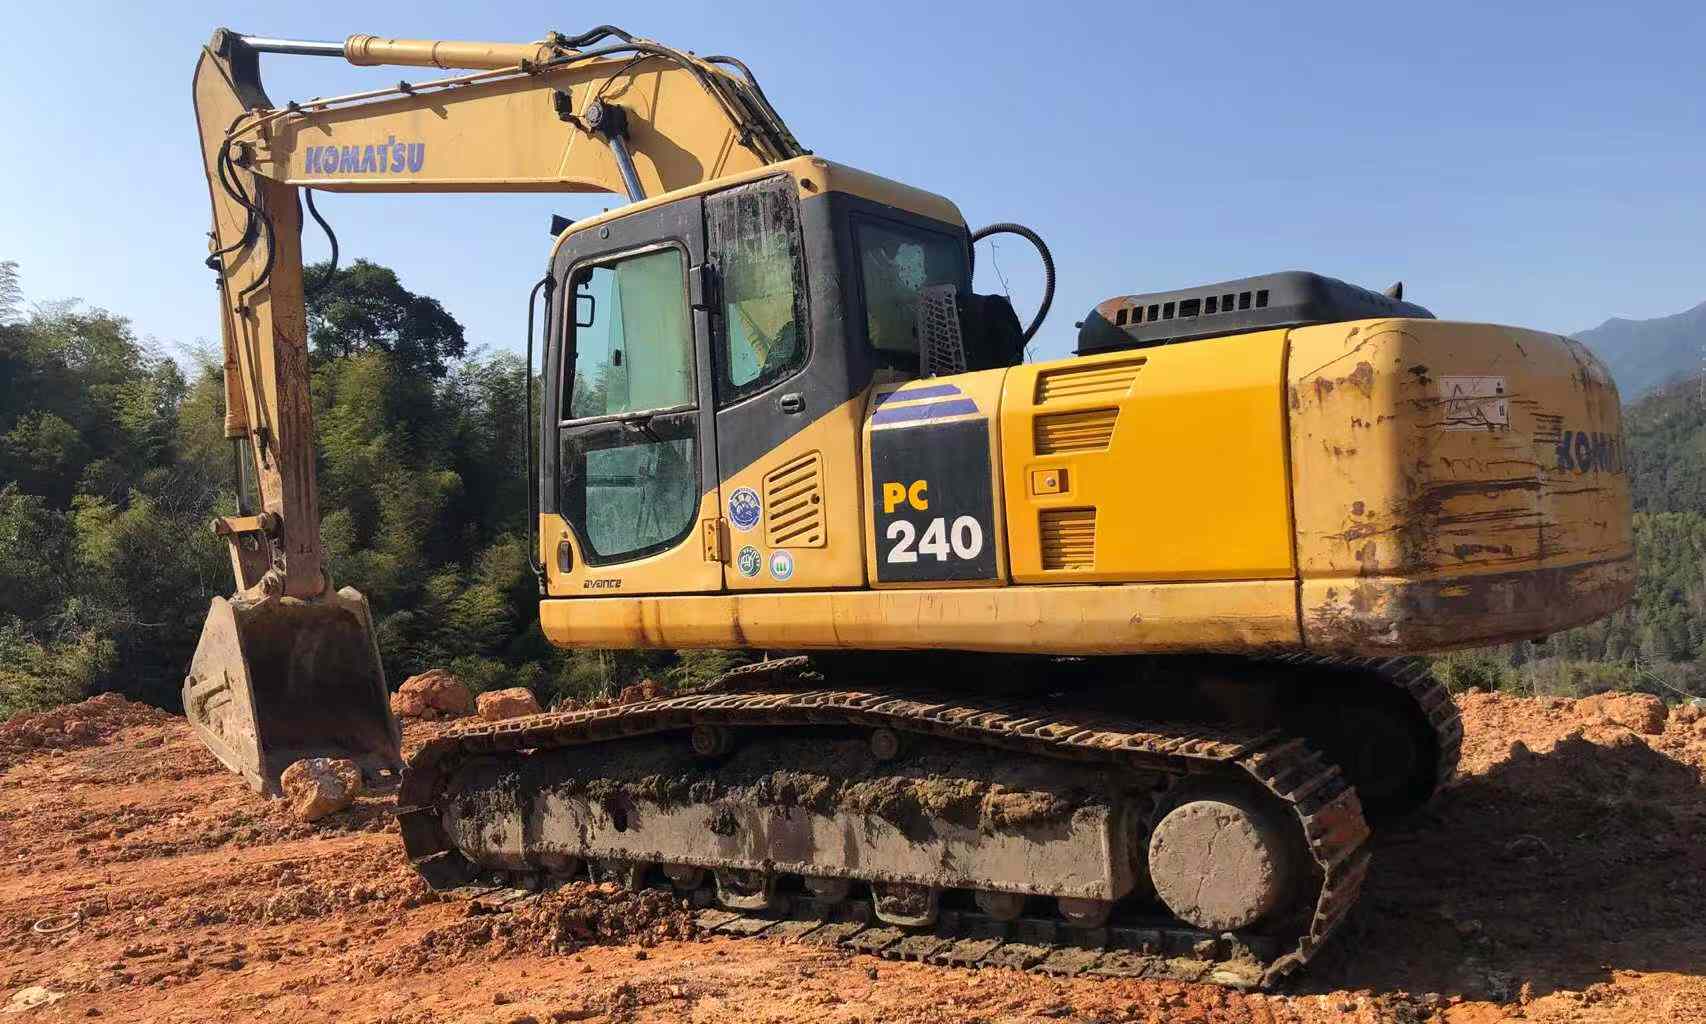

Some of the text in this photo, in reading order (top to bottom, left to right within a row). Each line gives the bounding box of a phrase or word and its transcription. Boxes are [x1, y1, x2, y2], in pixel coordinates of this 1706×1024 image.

[305, 136, 424, 173] KOMATSU
[883, 480, 928, 513] PC
[886, 515, 982, 563] 240
